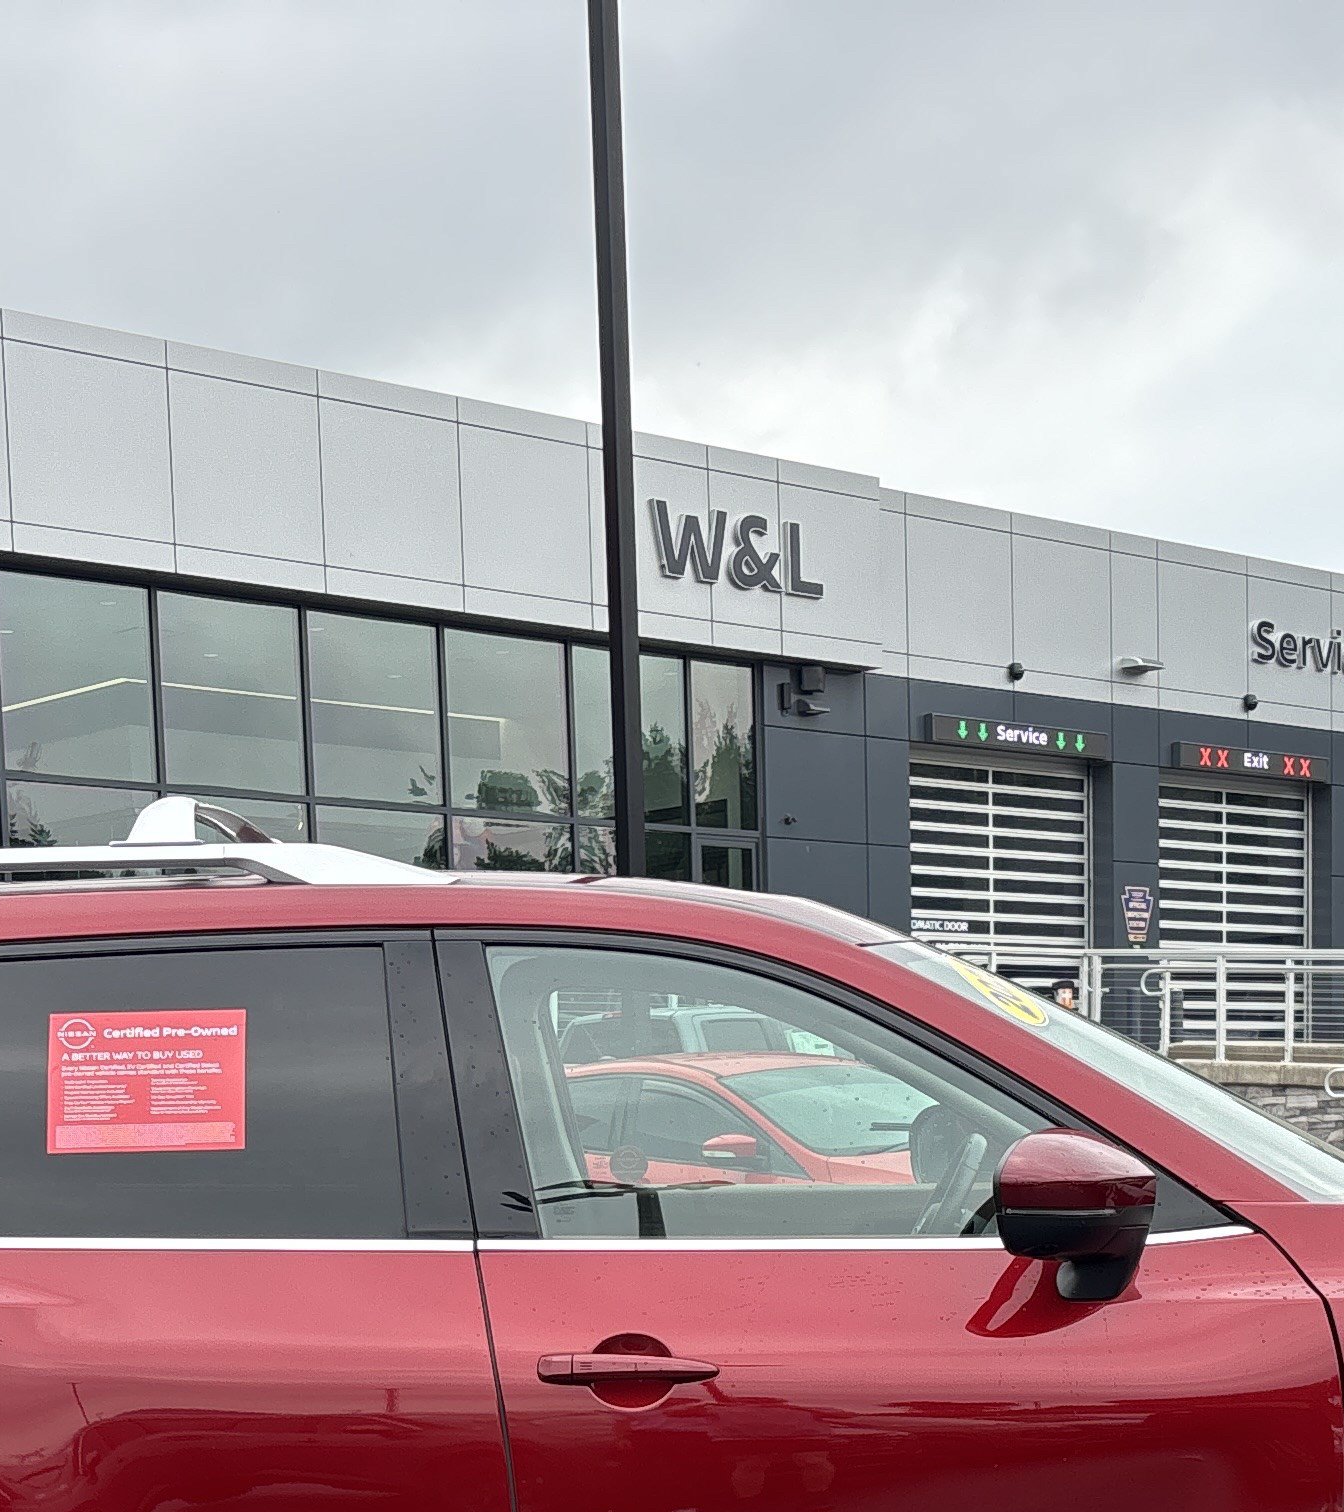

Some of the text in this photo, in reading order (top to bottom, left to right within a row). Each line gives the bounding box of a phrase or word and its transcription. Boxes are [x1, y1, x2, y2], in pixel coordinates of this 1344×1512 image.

[648, 498, 824, 600] W&L
[996, 725, 1048, 745] Service
[1243, 752, 1269, 770] Exit
[944, 921, 969, 932] DOOR
[57, 1030, 96, 1038] NISSAN
[103, 1025, 238, 1039] Certified Pre-Owned
[61, 1050, 204, 1061] A BETTER WAY TO BUY USED
